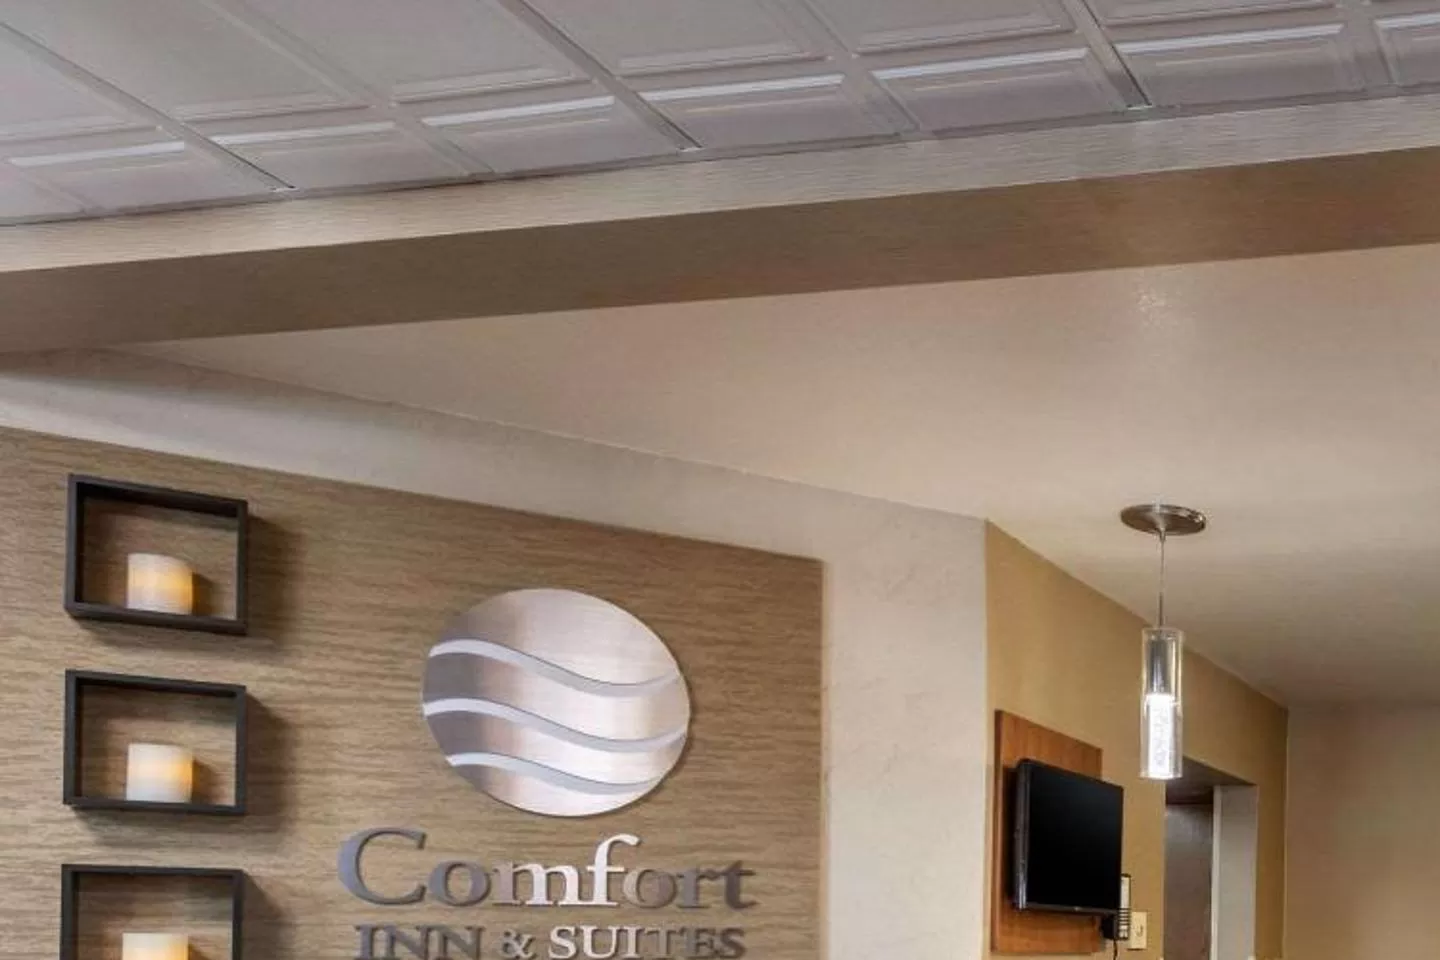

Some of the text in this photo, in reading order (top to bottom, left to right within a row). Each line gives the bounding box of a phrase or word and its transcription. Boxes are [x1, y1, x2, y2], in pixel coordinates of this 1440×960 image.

[337, 826, 757, 909] Comfort
[501, 928, 537, 960] &
[547, 924, 747, 960] SUITES
